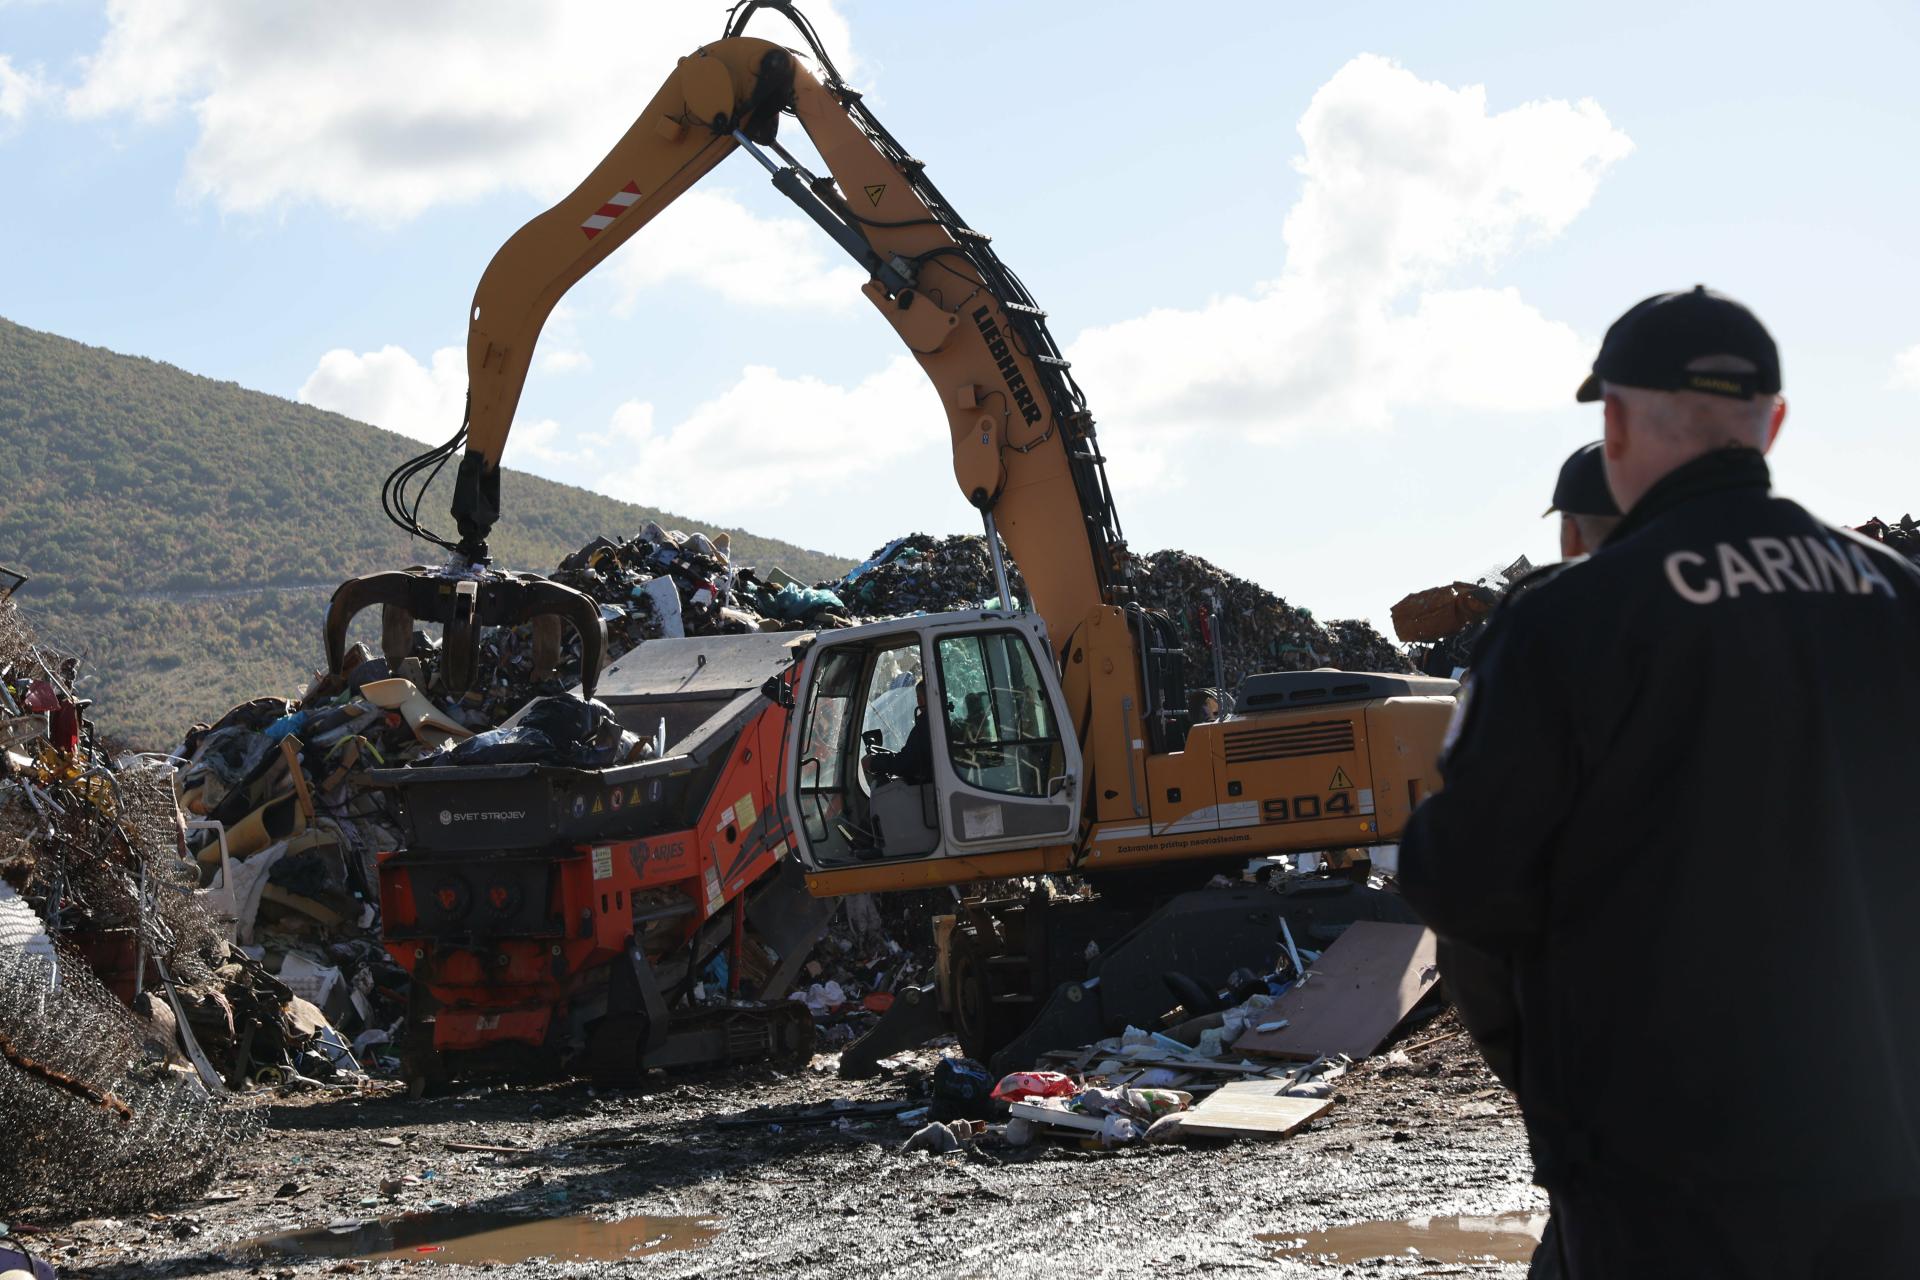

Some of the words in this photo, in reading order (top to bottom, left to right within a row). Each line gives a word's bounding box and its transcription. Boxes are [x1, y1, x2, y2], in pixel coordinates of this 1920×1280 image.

[972, 305, 1042, 427] LIEBHERR
[1664, 536, 1896, 605] CARINA
[453, 812, 479, 821] SVET
[480, 810, 526, 820] STROJEV
[1263, 792, 1353, 821] 904
[1160, 840, 1189, 851] pristup
